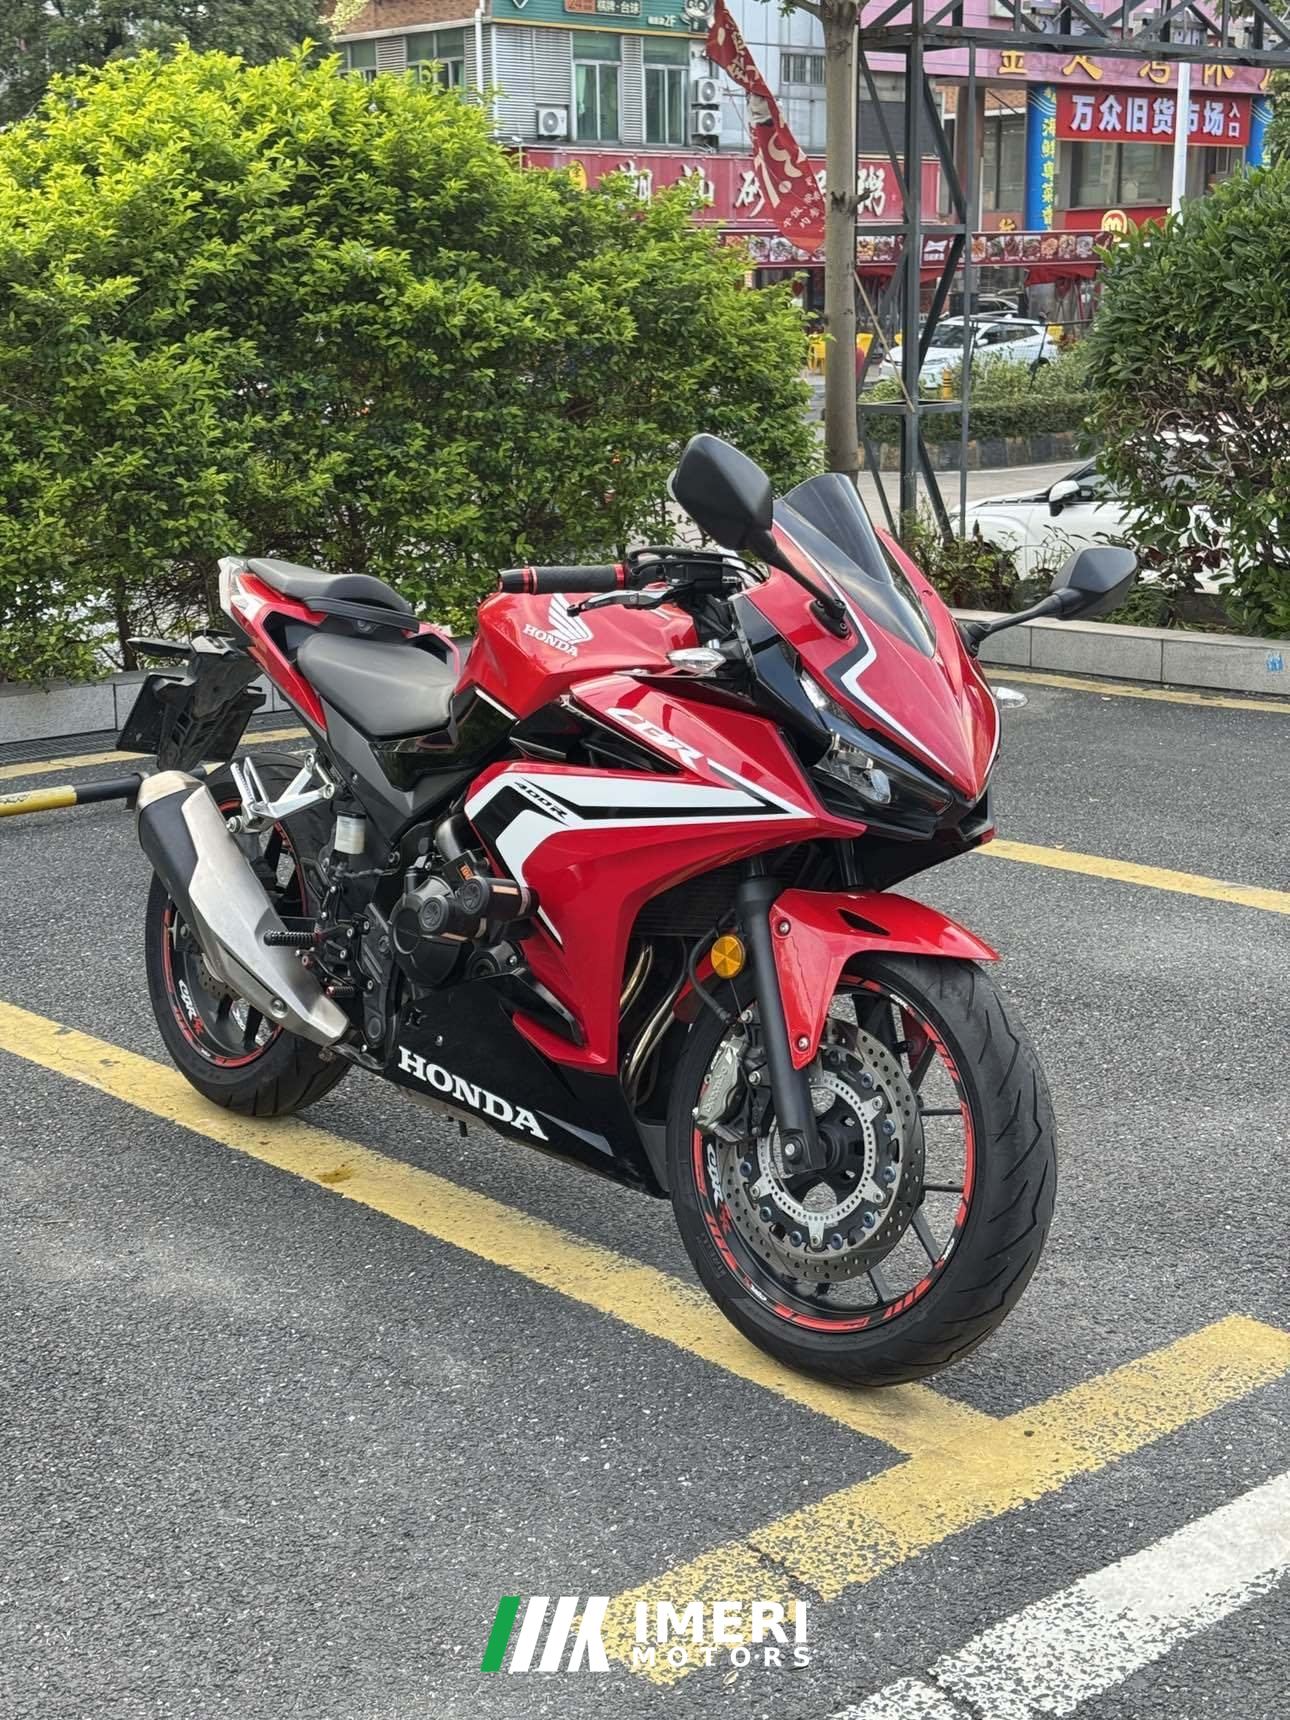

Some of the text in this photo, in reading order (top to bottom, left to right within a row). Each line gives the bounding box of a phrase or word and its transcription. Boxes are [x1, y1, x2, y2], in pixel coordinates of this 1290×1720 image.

[1228, 102, 1241, 137] 入口
[522, 624, 578, 657] HONDA
[606, 707, 704, 769] CBR
[514, 782, 568, 820] 400R
[398, 1046, 549, 1141] HONDA
